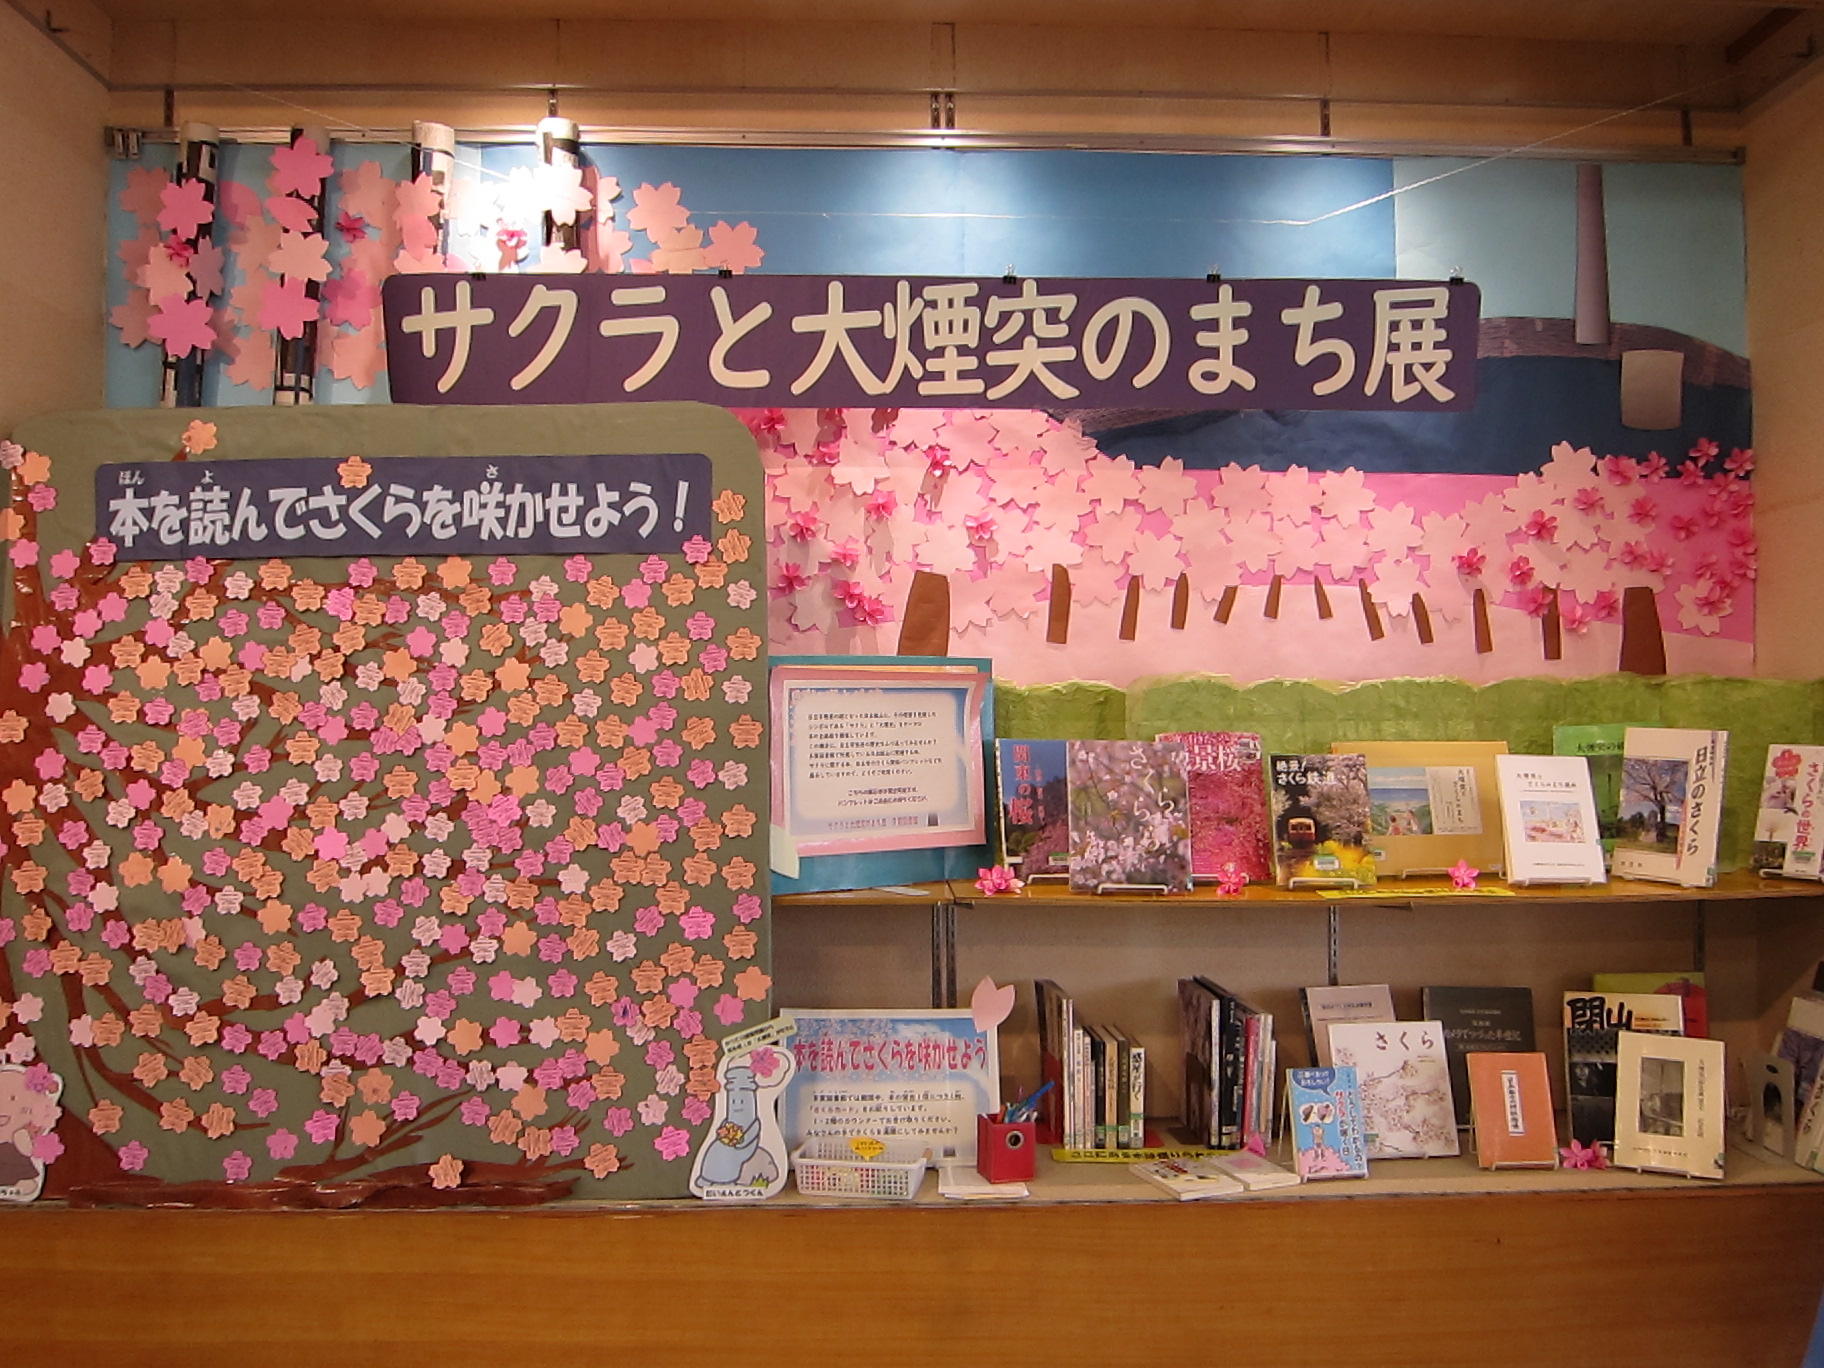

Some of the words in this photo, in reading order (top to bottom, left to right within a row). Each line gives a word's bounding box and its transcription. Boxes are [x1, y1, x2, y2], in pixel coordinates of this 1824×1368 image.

[401, 279, 1456, 402] サクラと大煙突のまち展
[109, 480, 690, 548] 本を読んでさくらを咲かせよう！
[1686, 745, 1708, 856] 日立のさくら
[1792, 761, 1820, 850] さくらの世界
[1375, 1029, 1436, 1051] さくら
